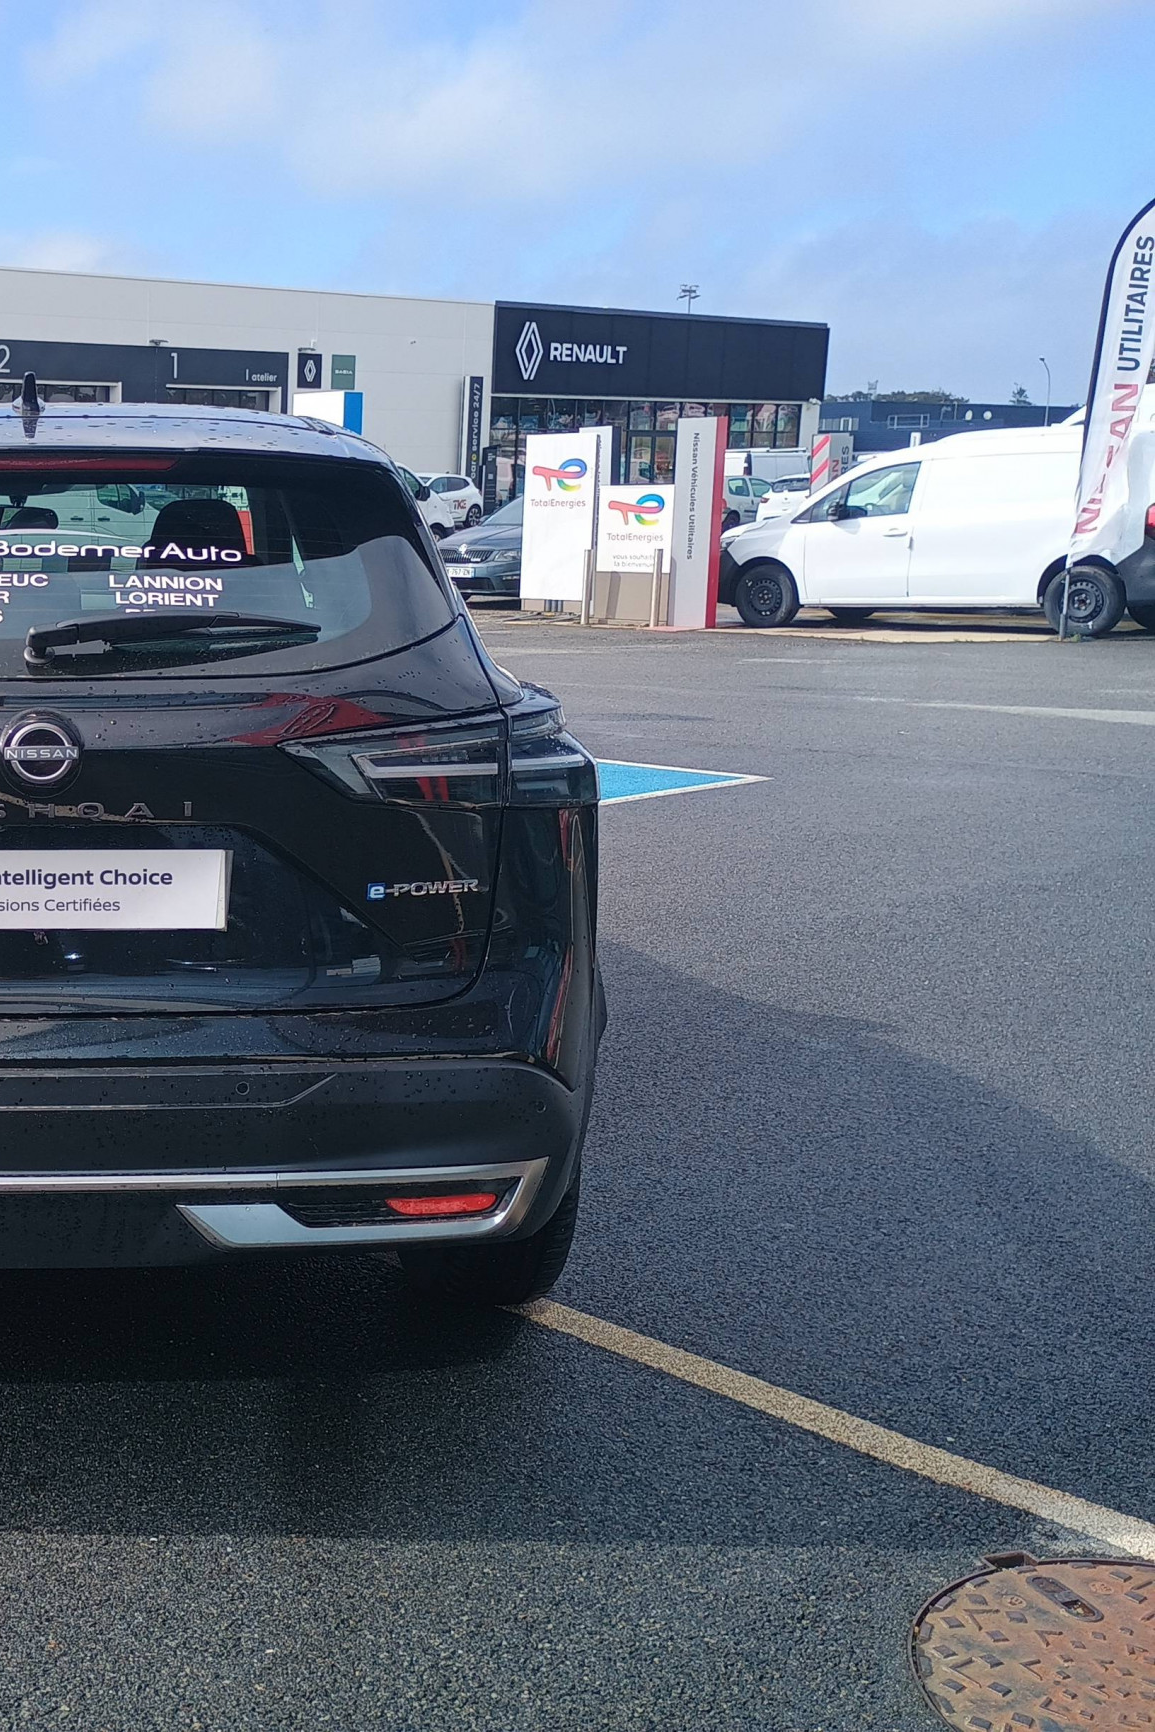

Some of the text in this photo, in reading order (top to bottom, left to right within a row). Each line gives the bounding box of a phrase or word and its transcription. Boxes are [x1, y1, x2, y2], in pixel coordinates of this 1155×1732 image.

[1117, 235, 1155, 371] UTILITAIRES
[549, 342, 628, 364] RENAULT
[170, 352, 178, 379] 1
[251, 372, 278, 382] atelier
[473, 383, 481, 407] 24/7
[472, 410, 480, 451] service
[691, 432, 700, 464] Nissan
[530, 499, 586, 509] TotalEnergies
[606, 533, 664, 543] TotalEnergies
[686, 514, 696, 560] Utilitaires
[160, 543, 242, 562] Auto
[108, 574, 223, 591] LANNION
[115, 591, 219, 607] LORIENT
[6, 747, 79, 759] NISSAN
[100, 869, 173, 886] Choice
[44, 898, 121, 912] Certifiées
